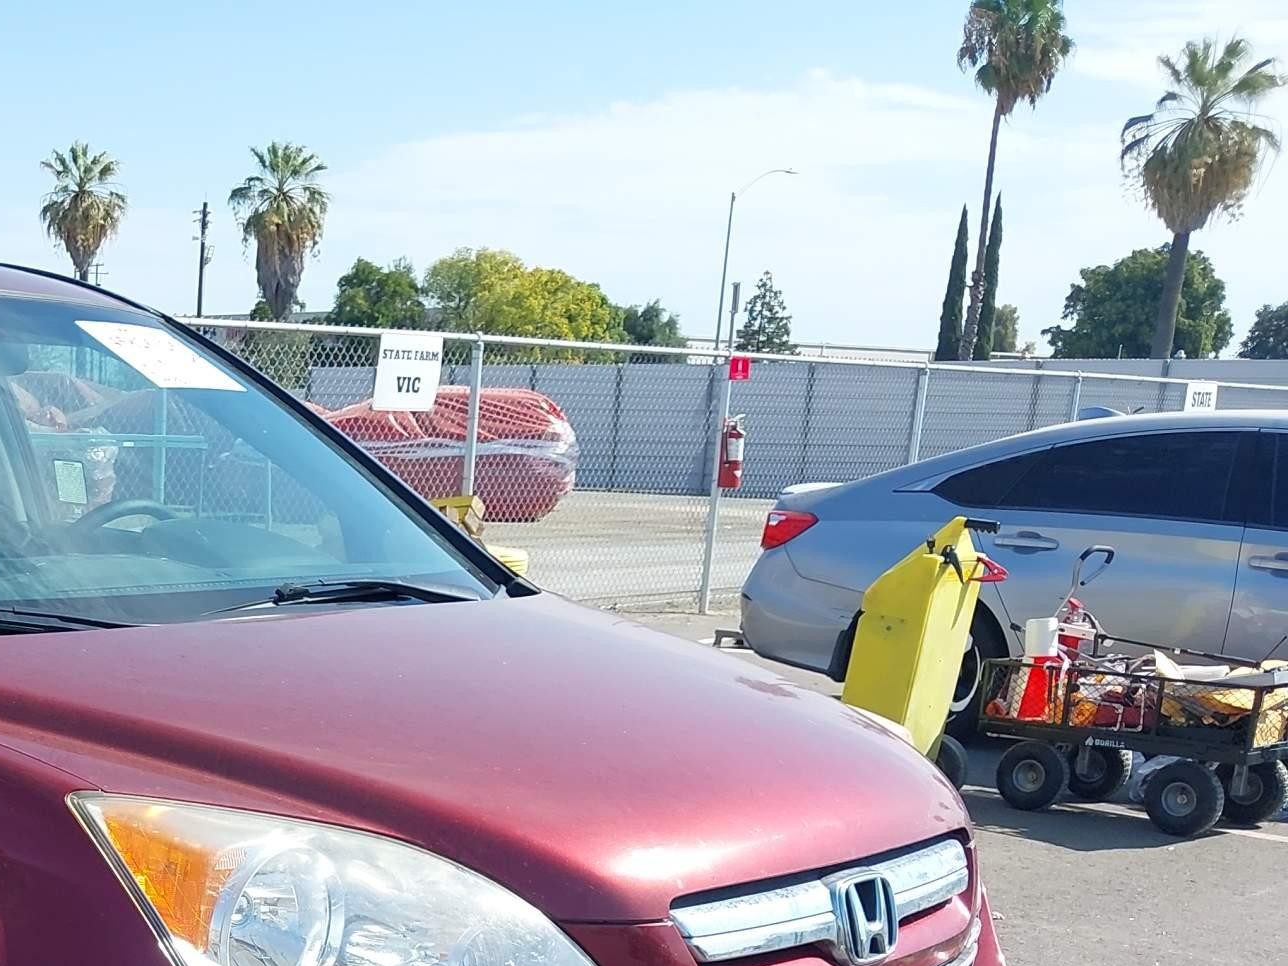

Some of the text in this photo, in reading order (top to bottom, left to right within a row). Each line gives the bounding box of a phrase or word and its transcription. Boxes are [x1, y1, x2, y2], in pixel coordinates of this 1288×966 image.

[382, 348, 439, 361] STATE FARM
[397, 375, 421, 393] VIC
[1191, 391, 1213, 408] STATE
